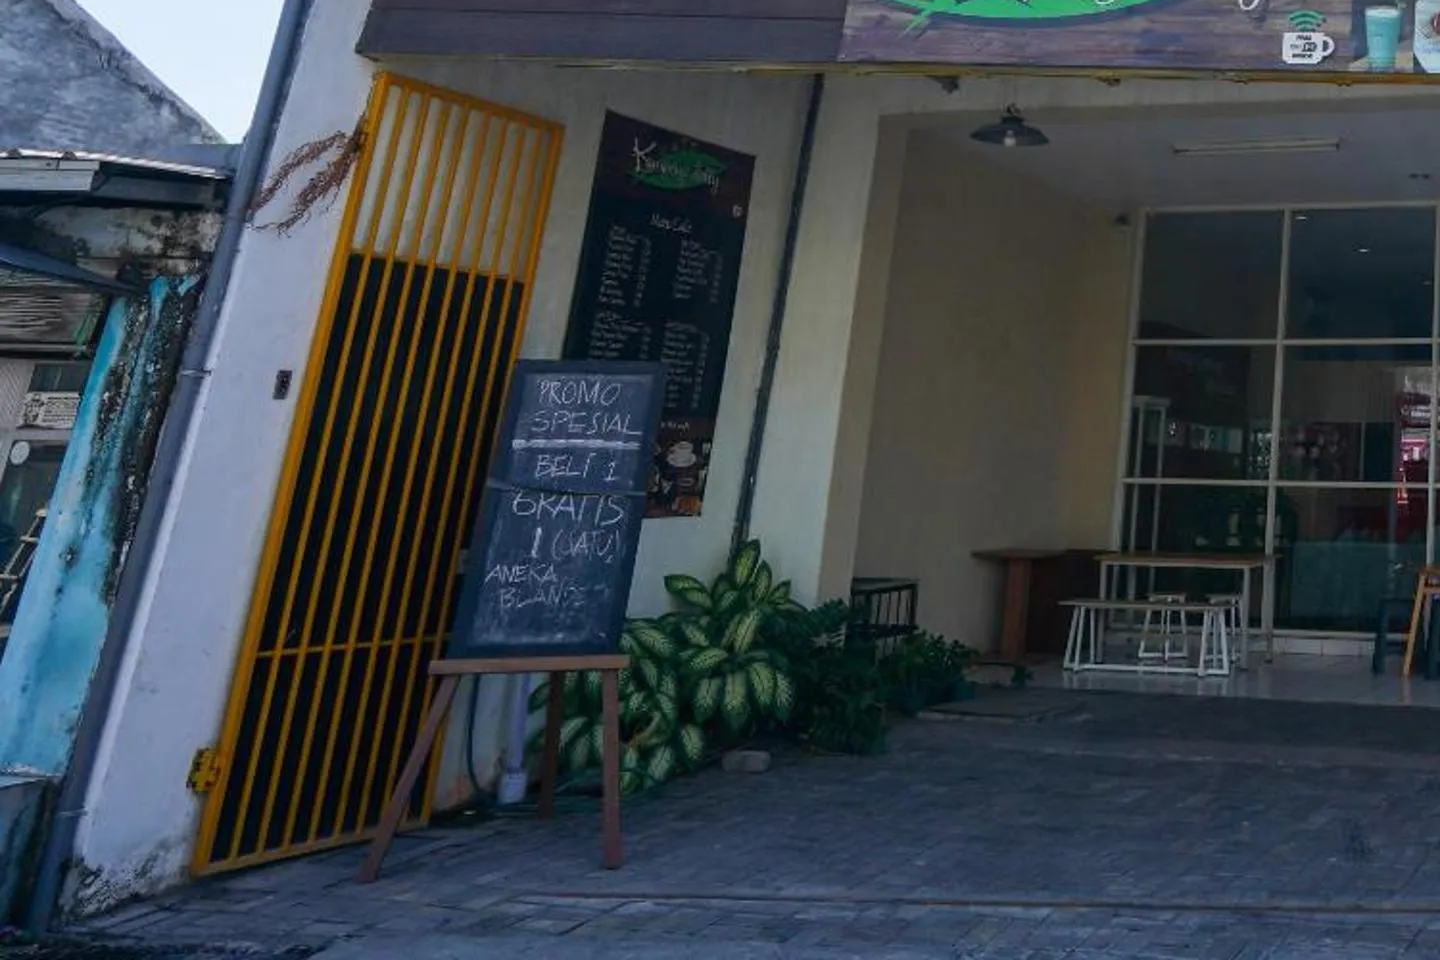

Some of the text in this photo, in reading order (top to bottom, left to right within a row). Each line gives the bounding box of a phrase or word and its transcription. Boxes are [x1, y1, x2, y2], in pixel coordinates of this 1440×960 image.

[538, 380, 622, 406] PROMO
[530, 410, 644, 436] SPESIAL
[603, 460, 618, 481] 1
[512, 491, 626, 527] GRATIS
